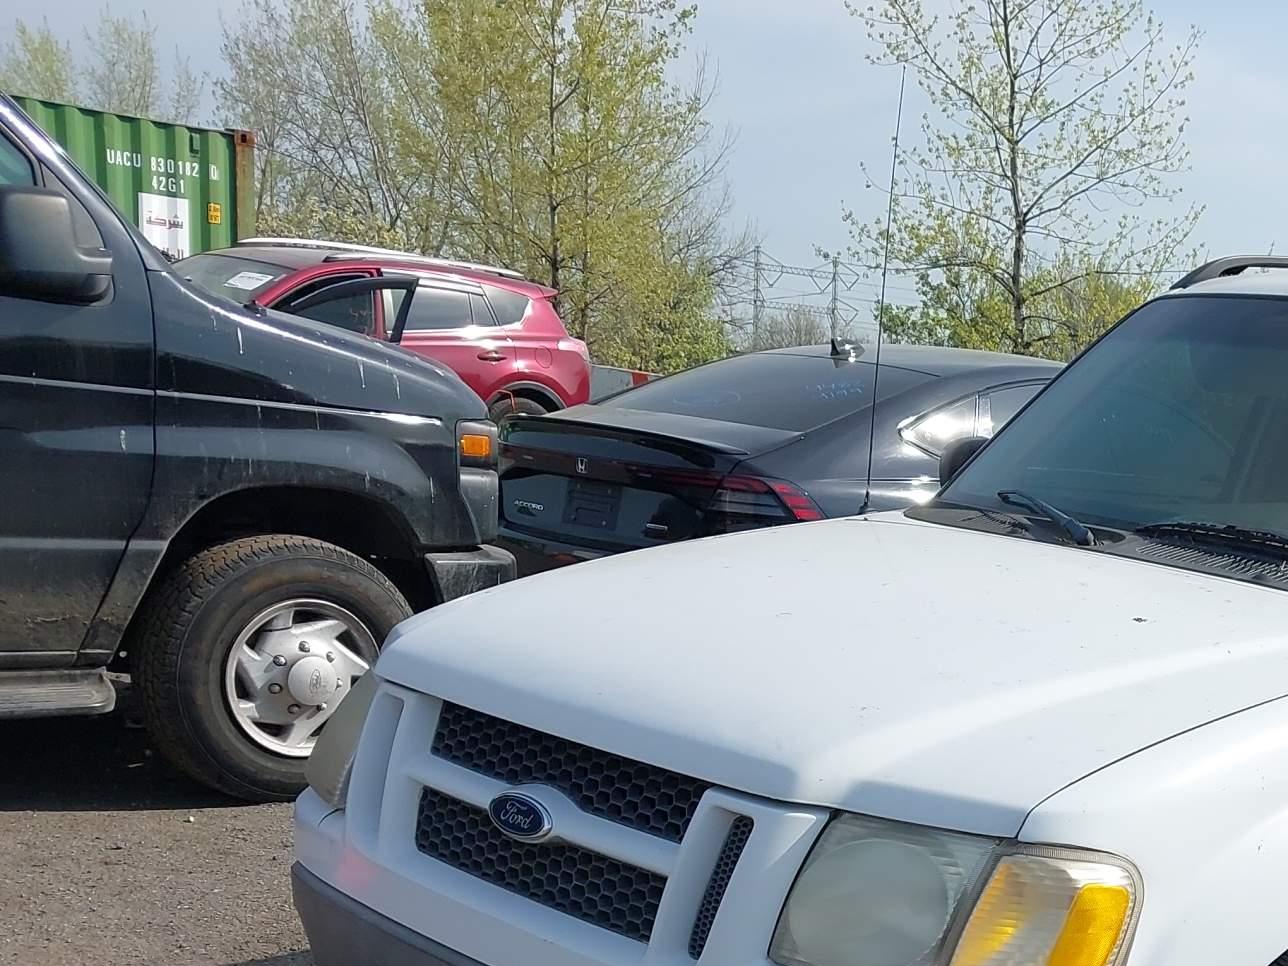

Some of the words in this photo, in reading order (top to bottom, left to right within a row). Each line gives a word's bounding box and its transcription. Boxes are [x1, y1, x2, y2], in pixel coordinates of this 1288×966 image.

[106, 148, 141, 168] UACU
[150, 156, 199, 178] 830182
[152, 175, 184, 194] 42G1
[513, 499, 544, 511] ACCORD
[500, 800, 534, 829] Ford
